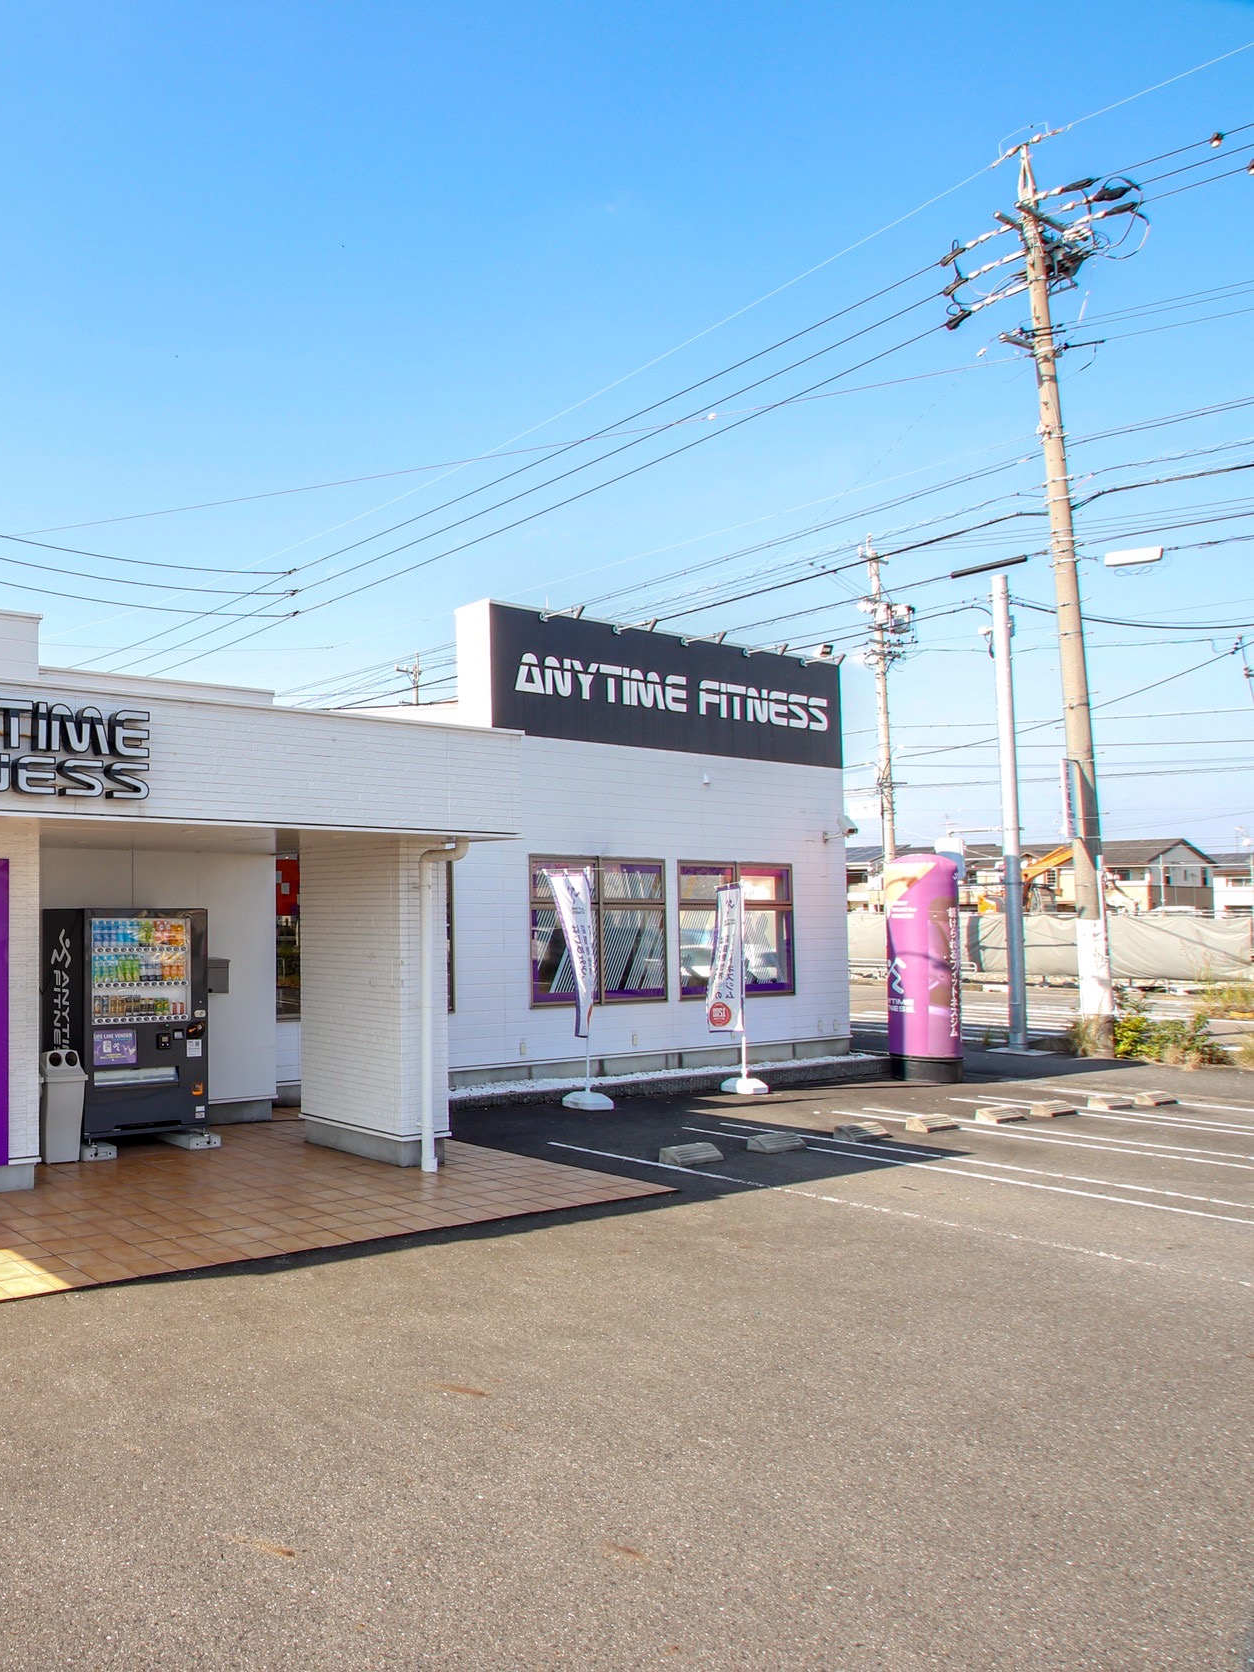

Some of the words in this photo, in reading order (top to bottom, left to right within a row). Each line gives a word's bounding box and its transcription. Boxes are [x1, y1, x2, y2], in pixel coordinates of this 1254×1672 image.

[514, 652, 687, 713] ANYTIME
[699, 679, 829, 731] FITNESS
[53, 969, 61, 1050] FITNE
